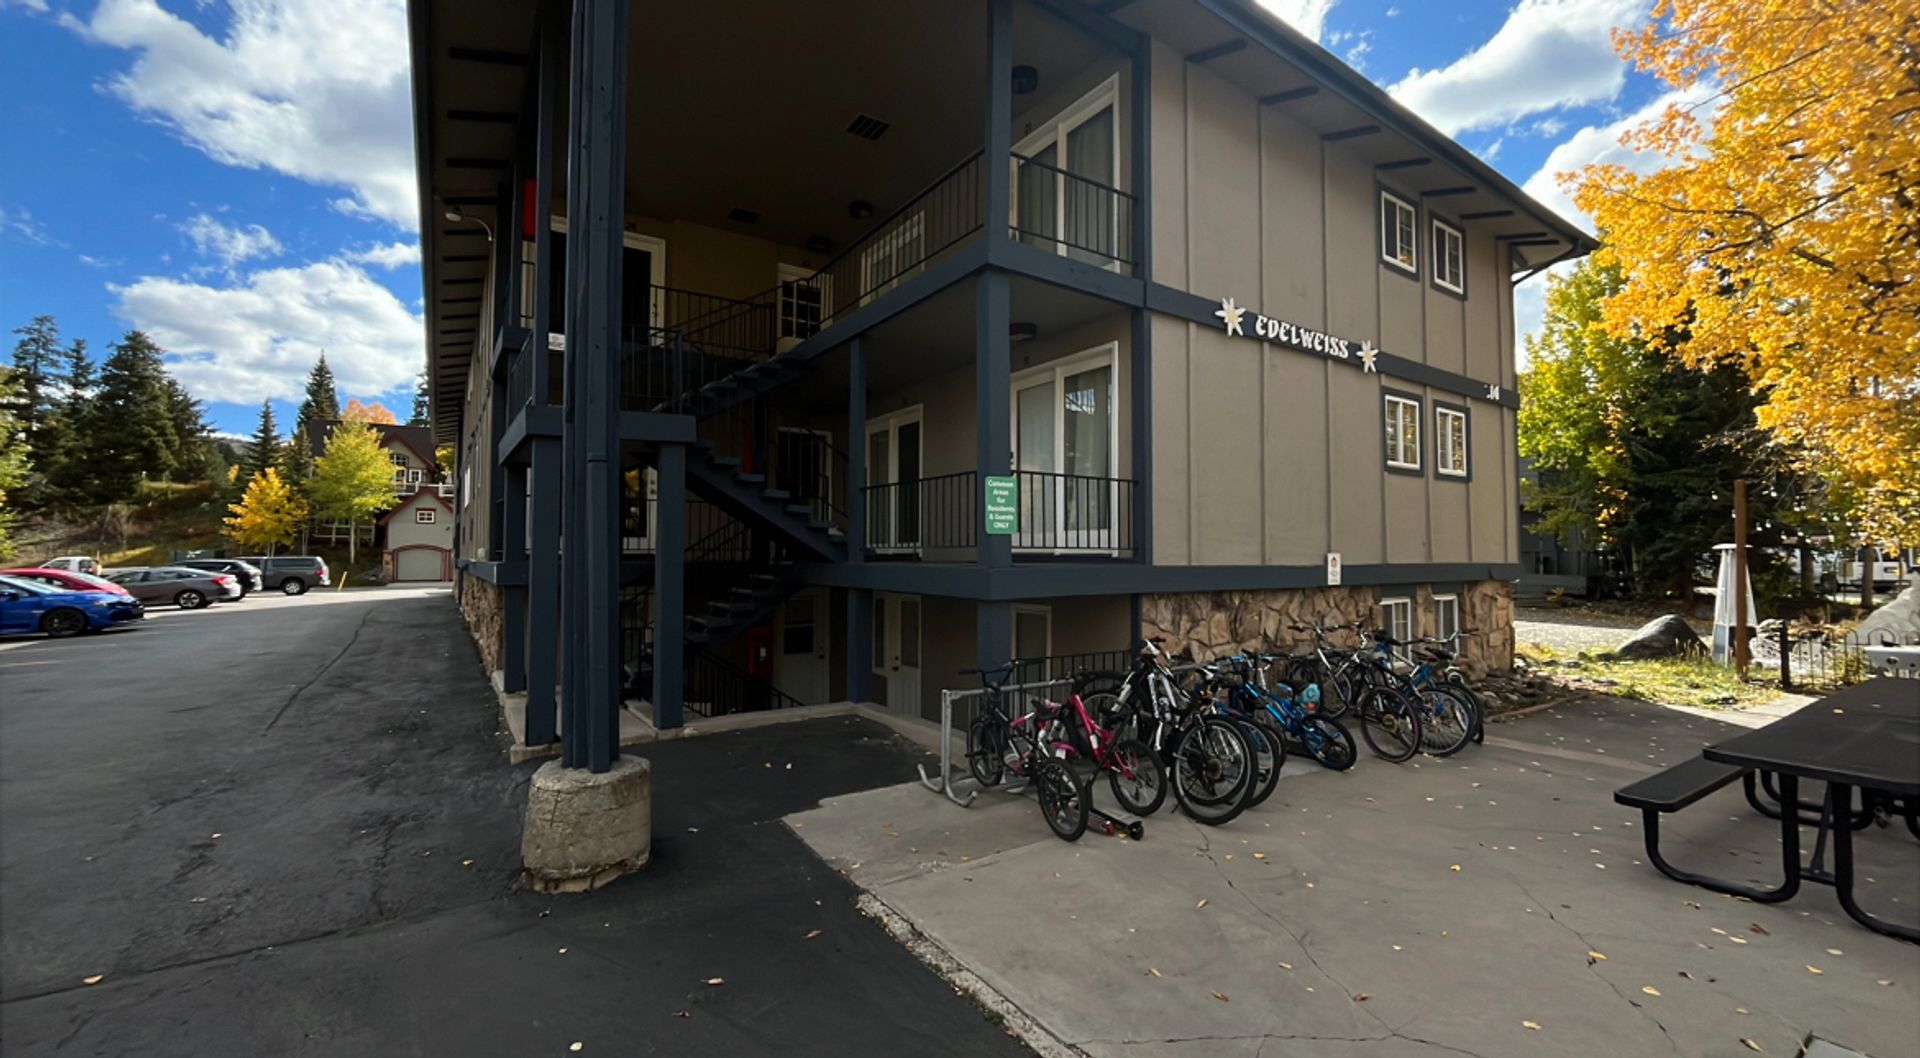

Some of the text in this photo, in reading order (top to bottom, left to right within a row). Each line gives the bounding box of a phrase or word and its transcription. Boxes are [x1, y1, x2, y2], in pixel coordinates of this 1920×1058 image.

[1255, 314, 1349, 359] EDELWEISS
[988, 479, 1014, 488] Common
[993, 488, 1009, 496] Areas
[987, 505, 1016, 513] Residents
[995, 513, 1014, 521] Guests
[993, 521, 1010, 529] ONLY
